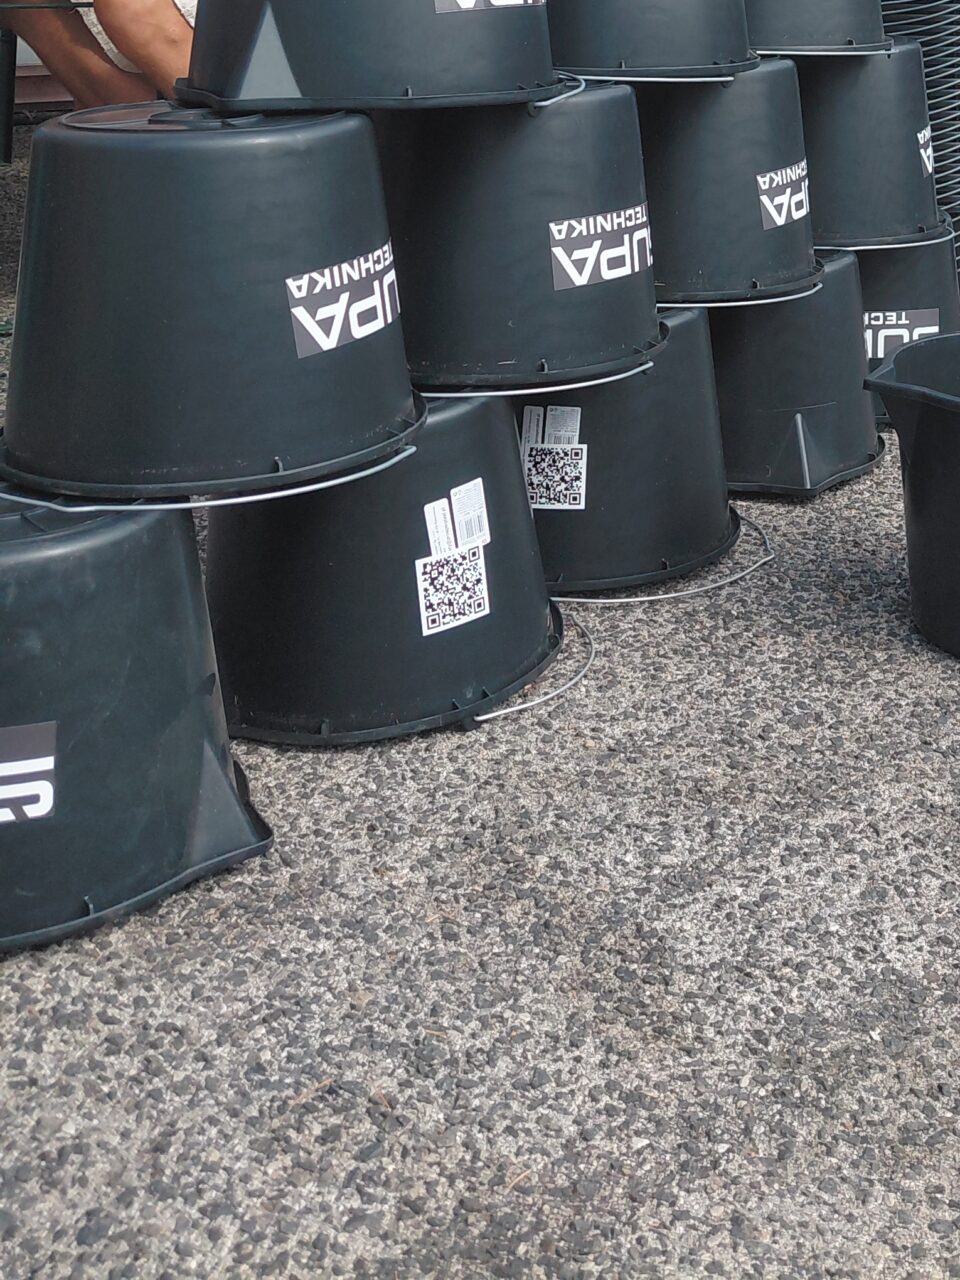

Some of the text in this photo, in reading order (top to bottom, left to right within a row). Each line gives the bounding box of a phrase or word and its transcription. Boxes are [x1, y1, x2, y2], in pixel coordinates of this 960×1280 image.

[549, 204, 648, 240] TECHNIKA
[551, 224, 654, 286] UPA
[290, 267, 401, 352] UPA
